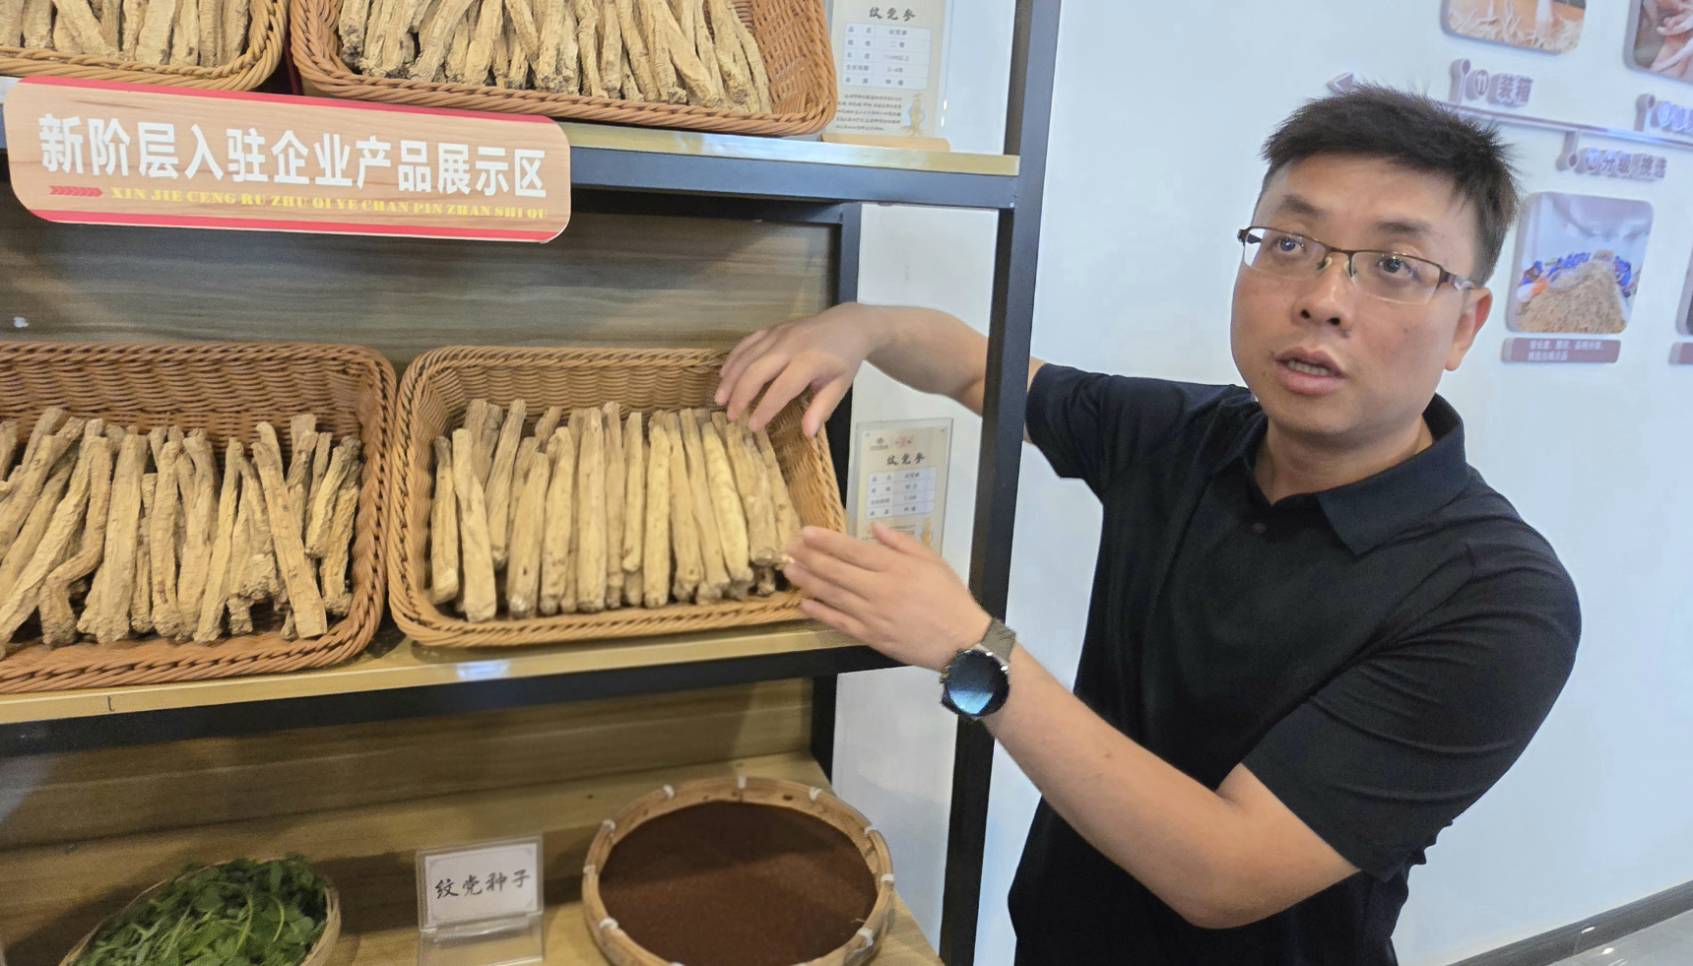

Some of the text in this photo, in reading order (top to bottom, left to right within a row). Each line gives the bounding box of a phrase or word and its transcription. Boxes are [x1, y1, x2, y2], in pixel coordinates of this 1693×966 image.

[38, 113, 547, 198] 新阶层入驻企业产品展示区
[111, 187, 547, 219] XIN JIE CENG RU ZHU QI YE CHAN PIN ZHAN SHI QU
[435, 868, 531, 899] 纹党种子
